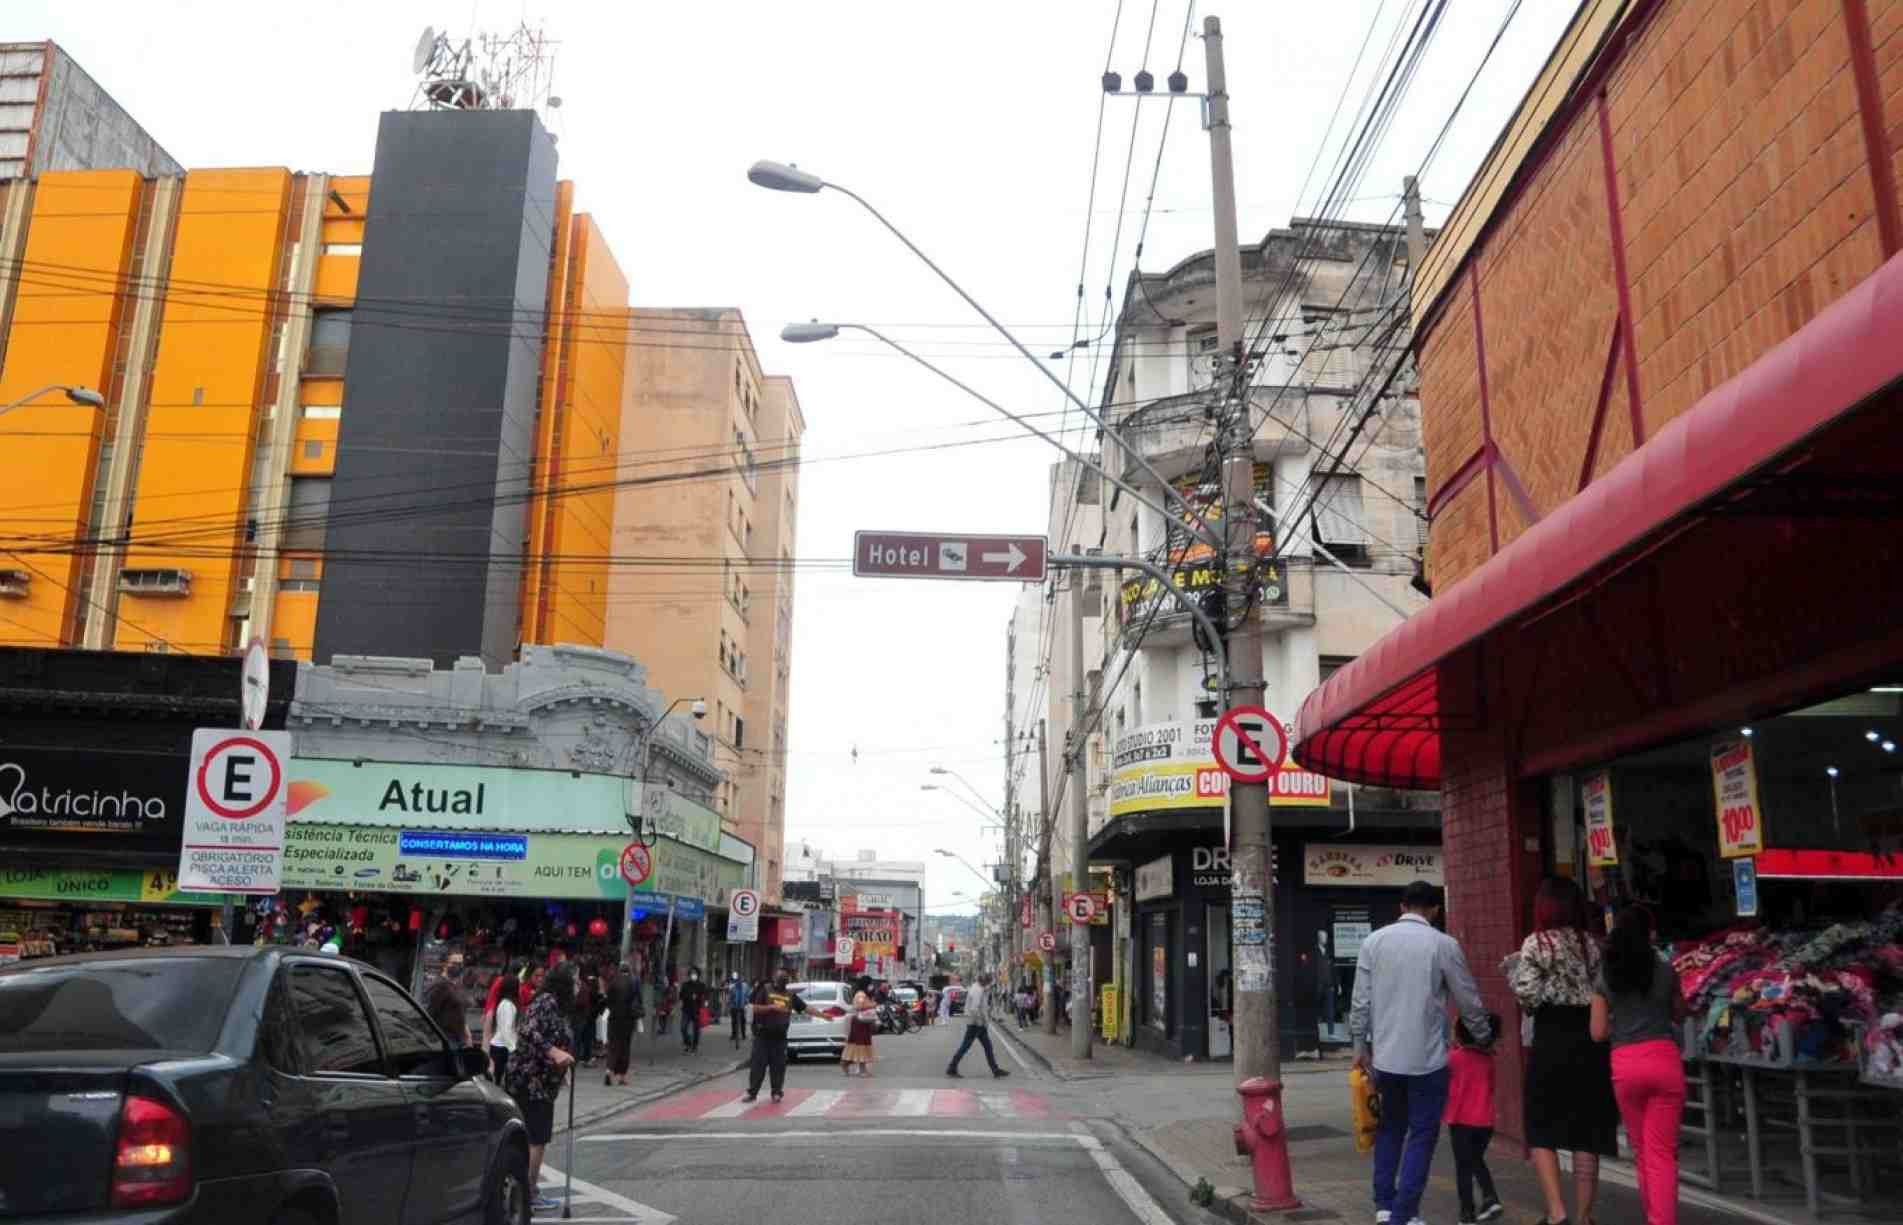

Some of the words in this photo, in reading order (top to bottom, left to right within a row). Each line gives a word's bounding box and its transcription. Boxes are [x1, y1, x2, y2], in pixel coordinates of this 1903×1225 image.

[869, 543, 929, 567] Hotel
[1156, 727, 1182, 744] 2001
[1237, 722, 1264, 765] E
[223, 755, 255, 802] E
[1278, 771, 1326, 795] OURO
[379, 778, 486, 815] Atual
[195, 821, 228, 833] VAGA
[284, 827, 343, 842] sistência
[347, 829, 398, 845] Técnica
[283, 844, 375, 862] Especializada
[400, 839, 479, 851] CONSERTAMOS
[190, 863, 225, 874] PISCA
[227, 864, 273, 875] ALERTA
[534, 865, 564, 878] AQUI
[567, 866, 592, 878] TEM
[209, 874, 252, 887] ACESO
[740, 896, 750, 911] E
